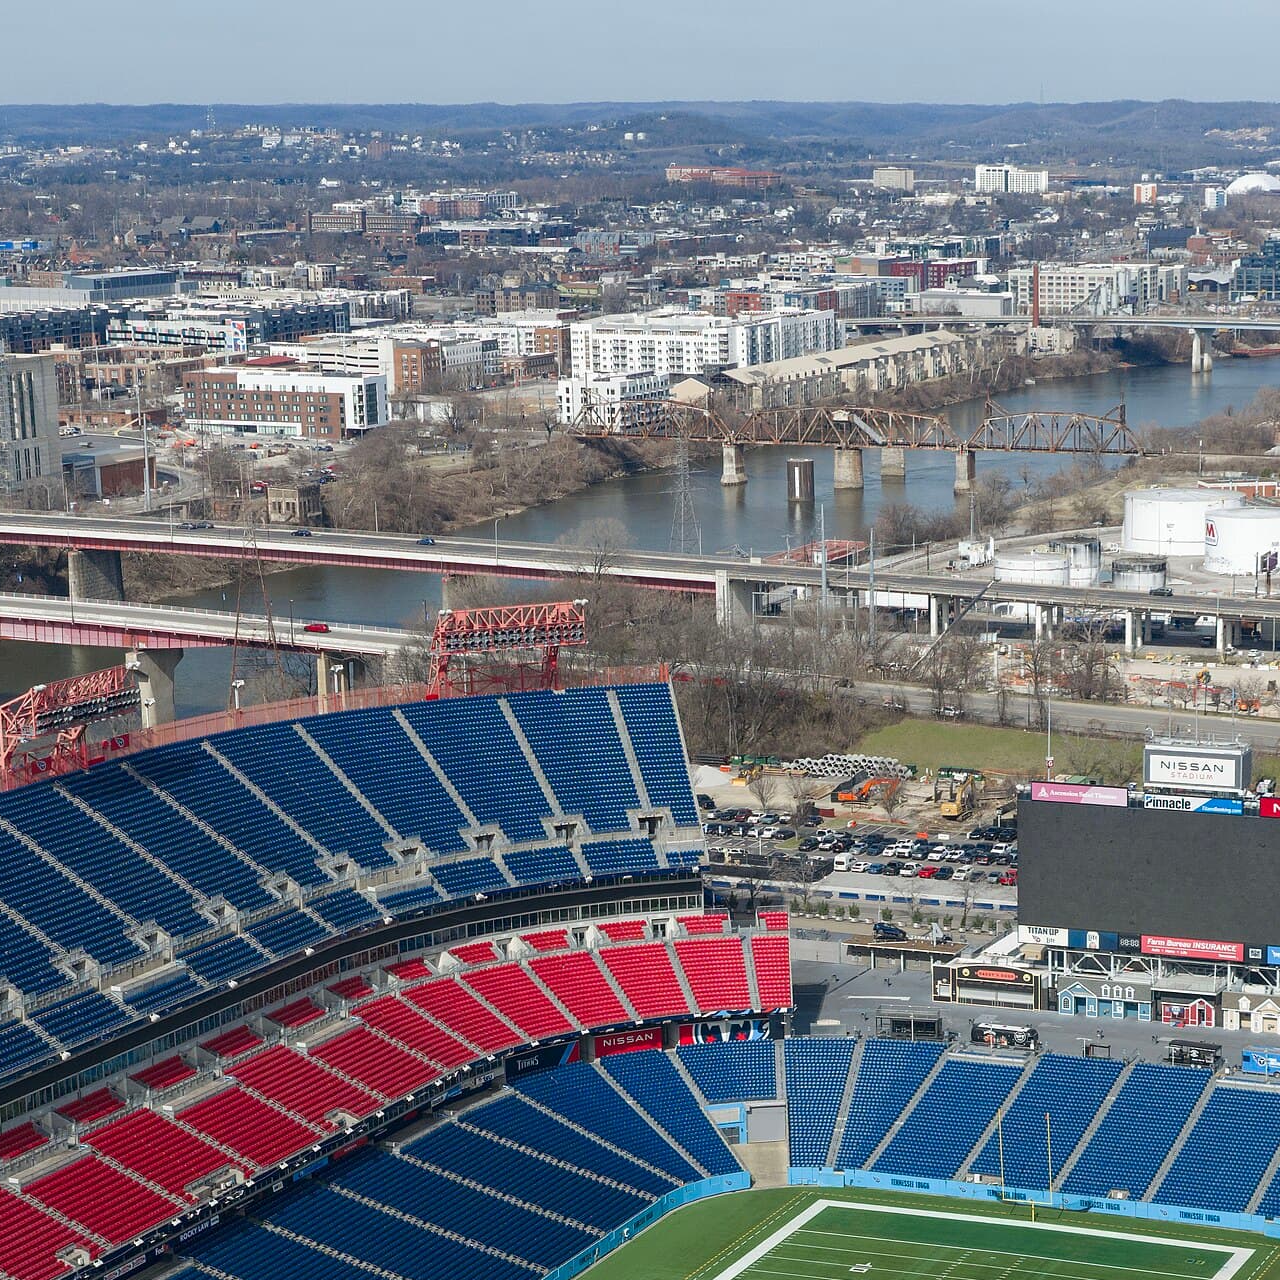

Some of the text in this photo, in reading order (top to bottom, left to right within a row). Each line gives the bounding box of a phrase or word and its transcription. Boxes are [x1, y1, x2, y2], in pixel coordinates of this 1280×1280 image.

[1160, 760, 1224, 773] NISSAN
[1171, 772, 1213, 780] STADIUM
[1146, 796, 1191, 810] Pinnacle
[1028, 927, 1048, 935] TITAN
[1147, 938, 1237, 952] Farm Bureau INSURANCE
[603, 1033, 653, 1047] NISSAN
[891, 1178, 930, 1190] TENNESSEE TOUGH
[1180, 1210, 1220, 1223] TENNESSEE TOUGH
[180, 1224, 210, 1242] ROCKY LAW
